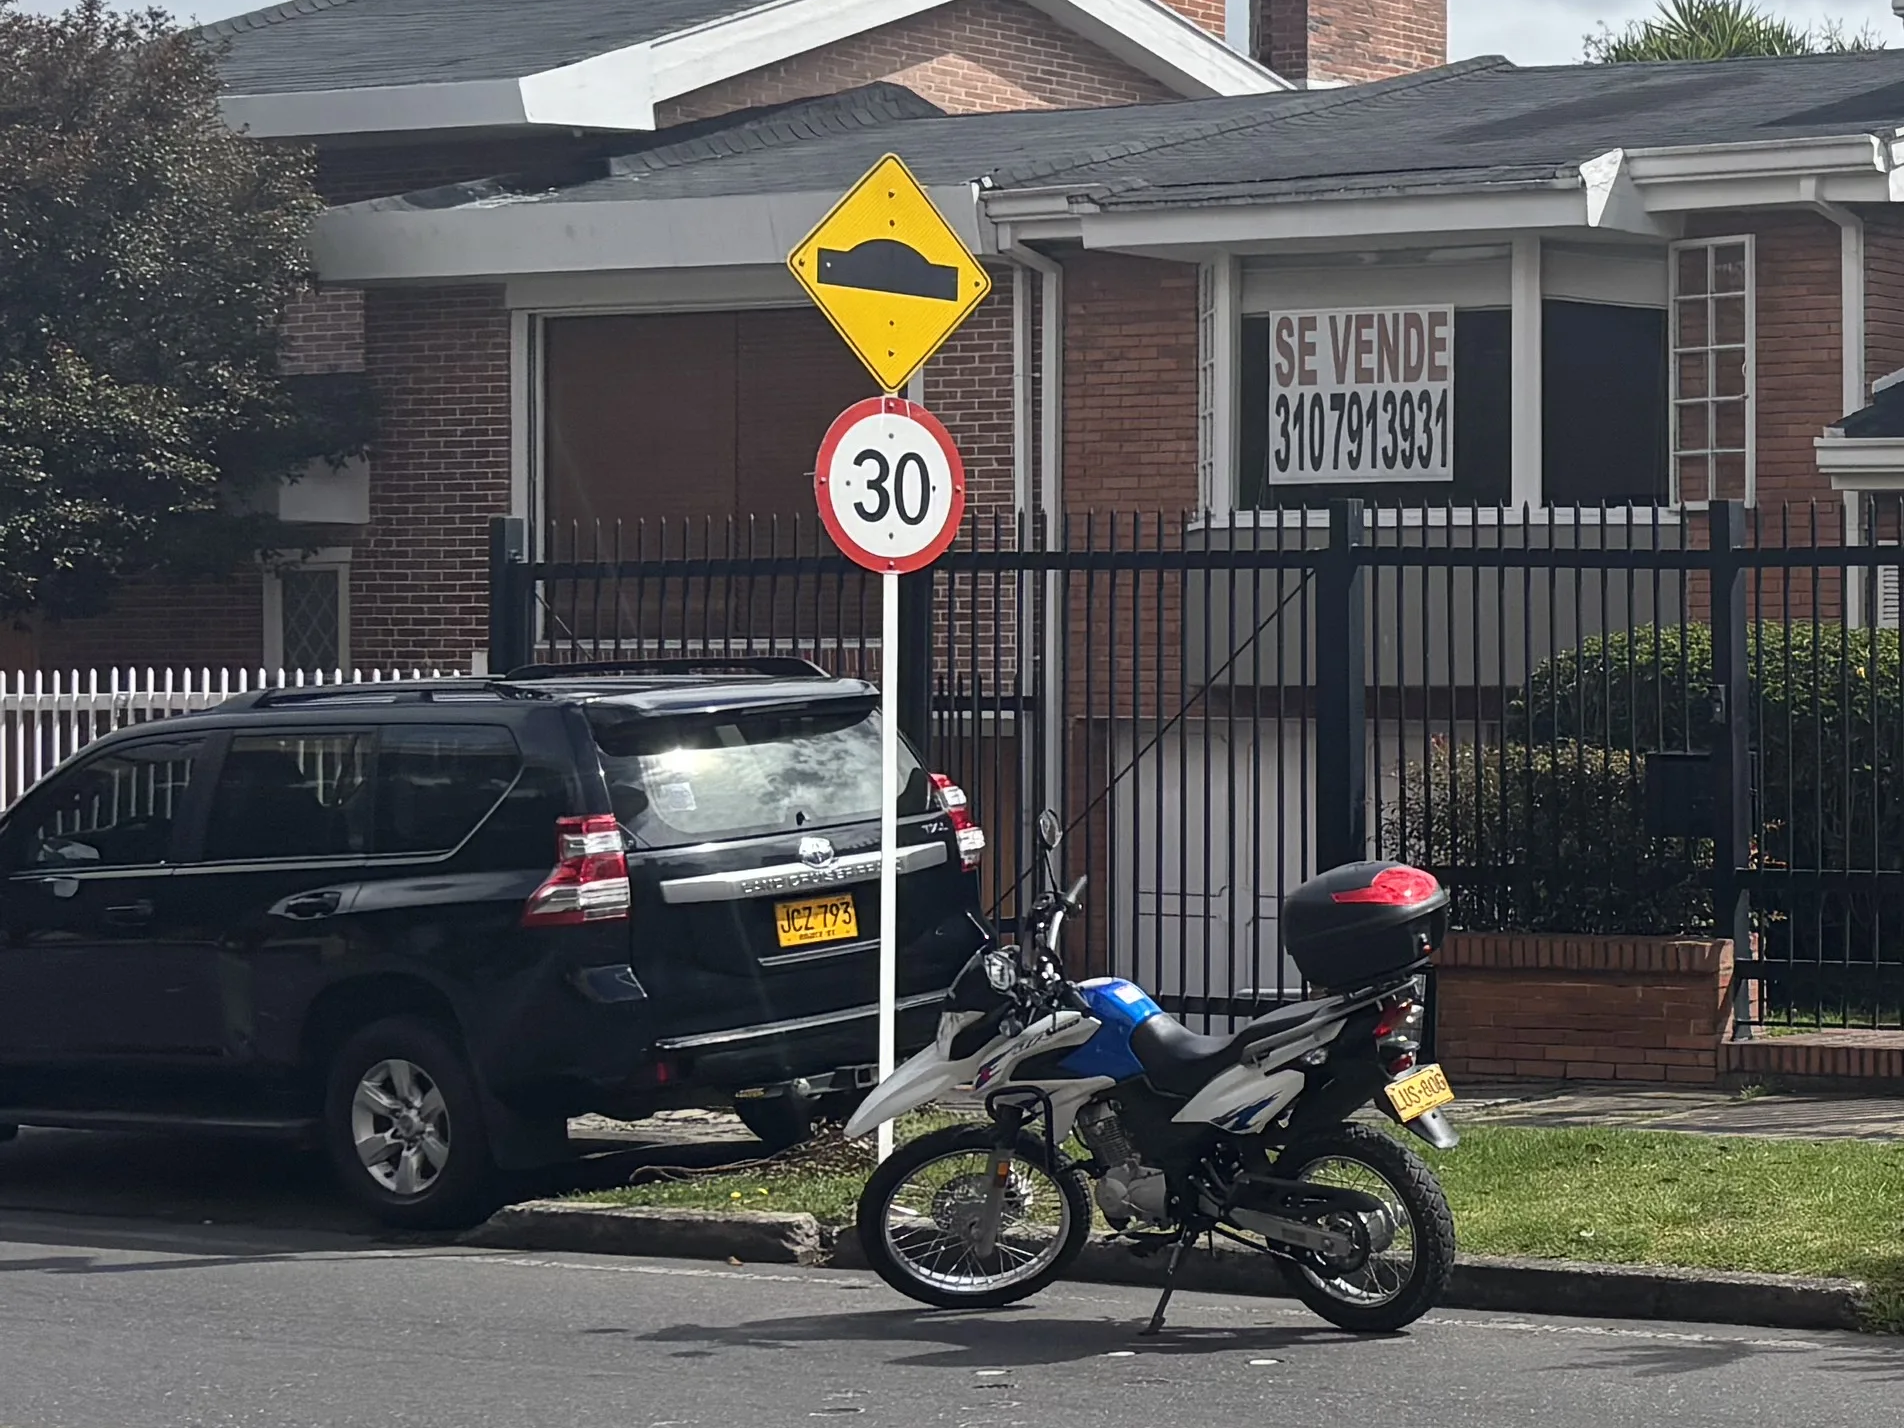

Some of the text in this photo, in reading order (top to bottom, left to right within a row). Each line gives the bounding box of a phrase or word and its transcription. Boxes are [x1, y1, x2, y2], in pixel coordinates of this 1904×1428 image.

[1275, 312, 1448, 388] SE VENDE
[1274, 388, 1448, 473] 3107913931
[853, 448, 931, 526] 30
[780, 901, 852, 934] JCZ 793
